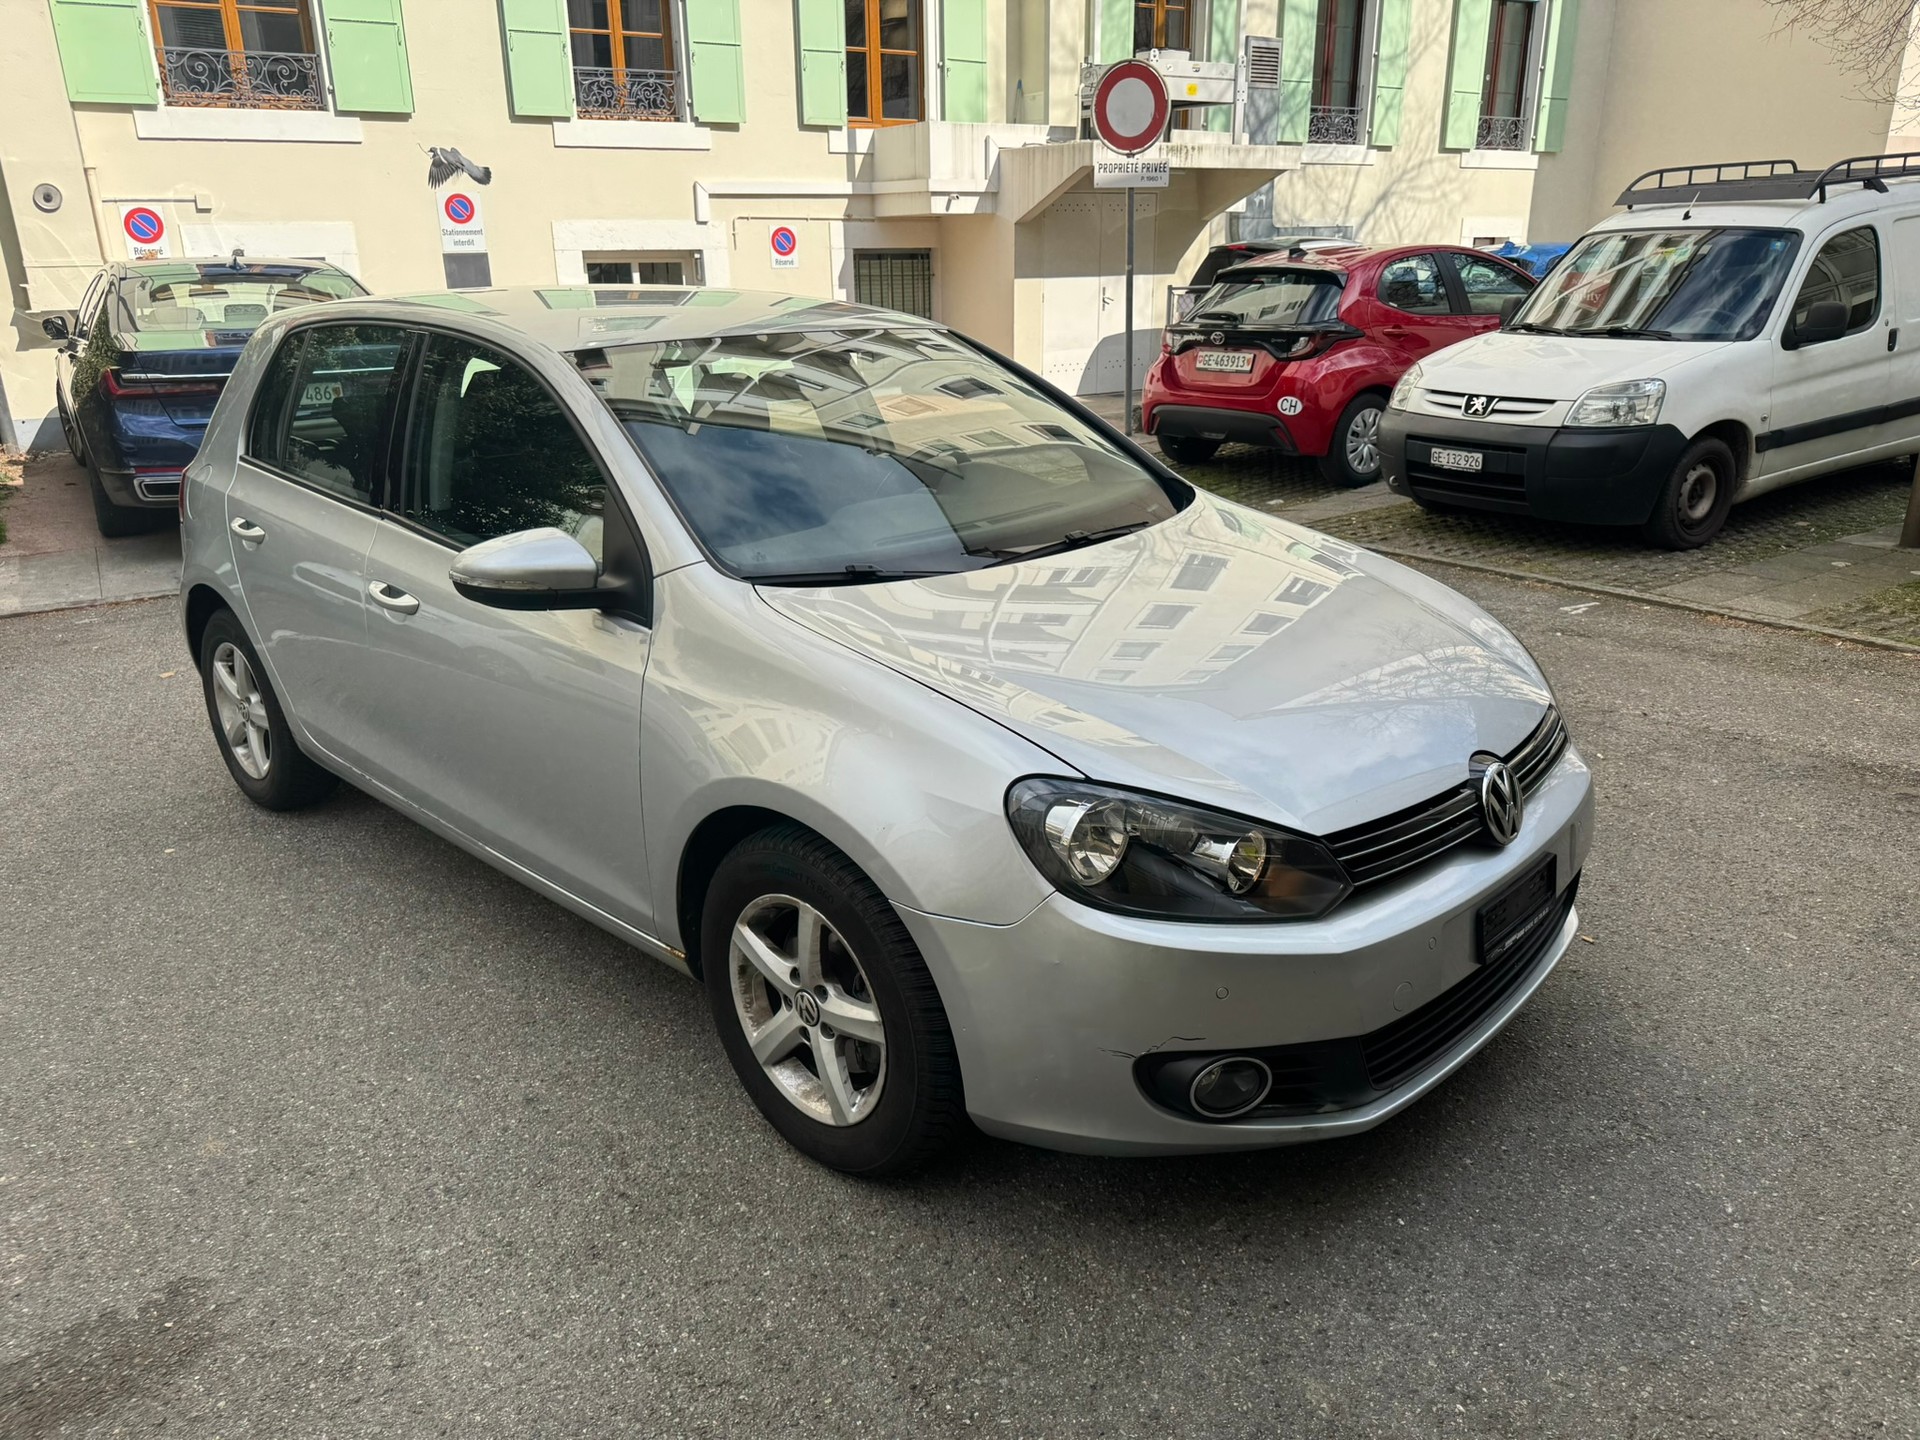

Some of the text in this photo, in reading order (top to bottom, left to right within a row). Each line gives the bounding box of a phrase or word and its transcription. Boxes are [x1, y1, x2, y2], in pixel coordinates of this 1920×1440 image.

[1098, 160, 1168, 174] PROPRIÉTÉ PRIVÉE
[442, 228, 483, 236] Stationnement
[775, 258, 794, 266] Réservé
[1280, 398, 1298, 414] CH
